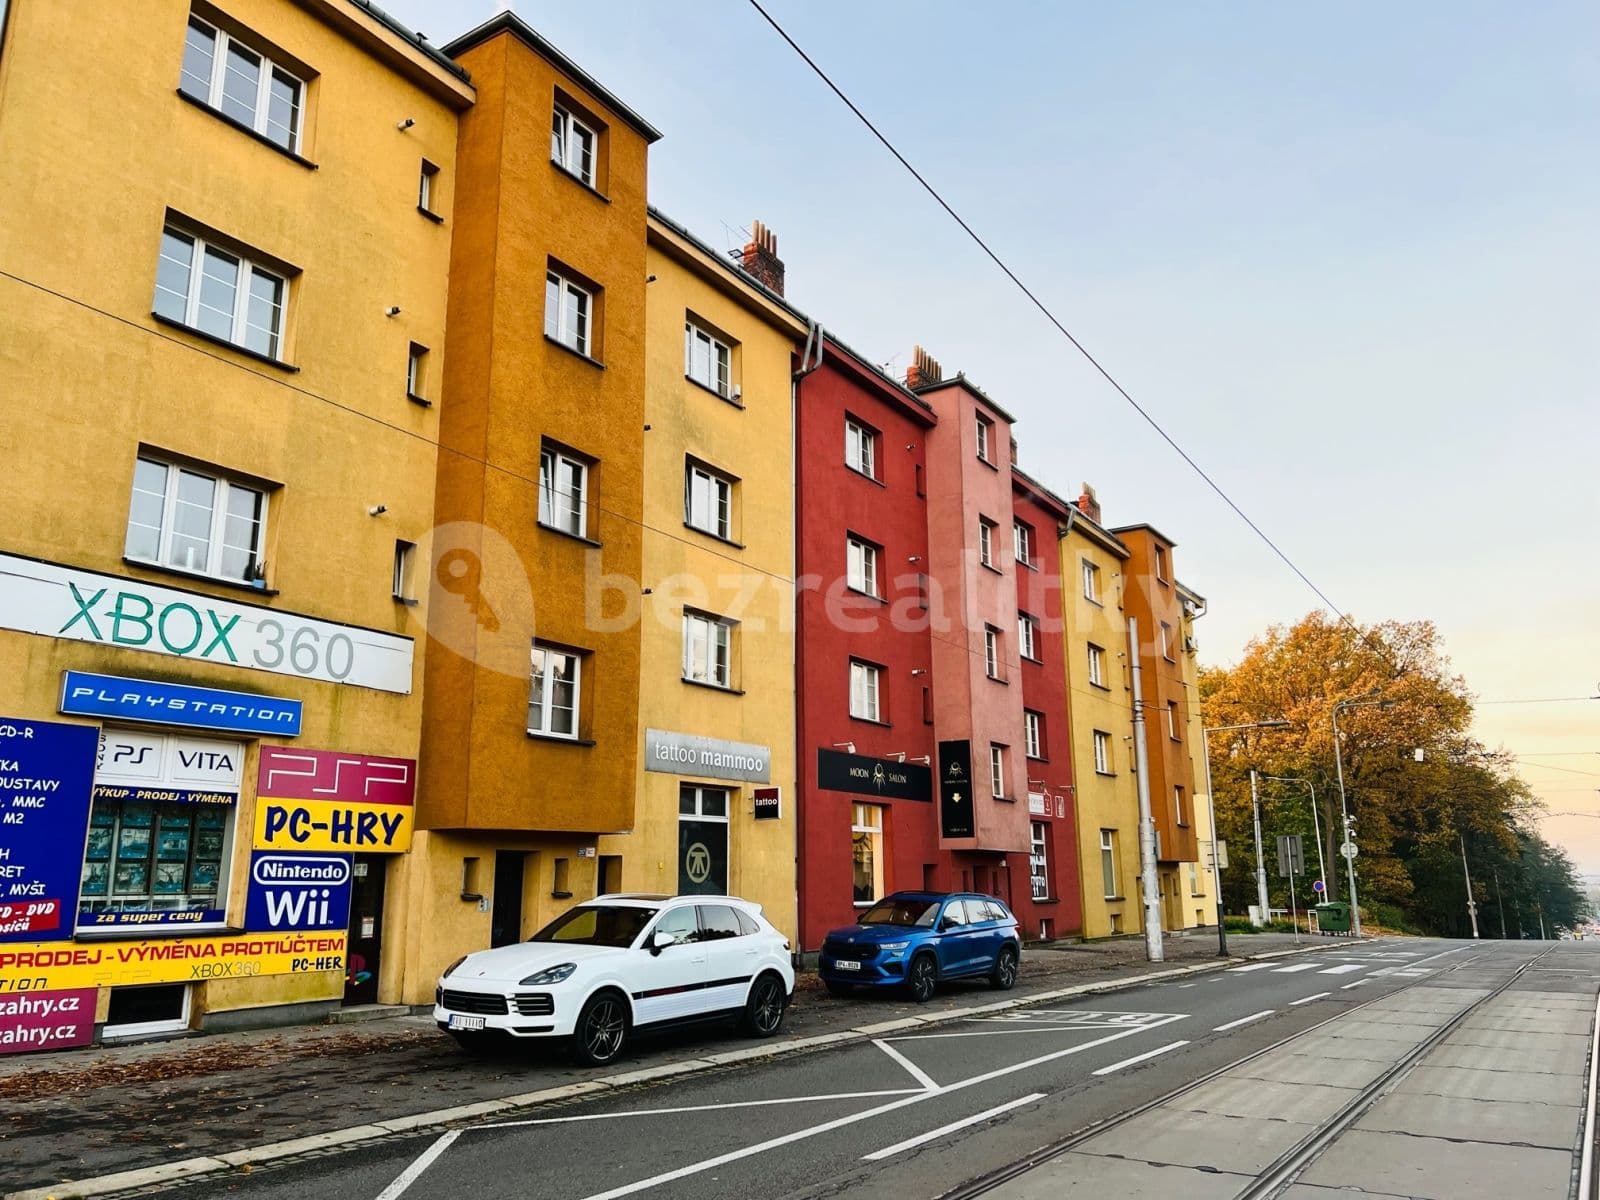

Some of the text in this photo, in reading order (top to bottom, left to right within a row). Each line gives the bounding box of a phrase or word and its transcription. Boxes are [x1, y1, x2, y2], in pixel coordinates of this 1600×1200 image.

[59, 581, 354, 680] XBOX 360
[114, 744, 234, 771] PS VITA
[655, 740, 764, 772] tattoo mammoo
[0, 760, 19, 772] KA
[268, 753, 408, 796] PSP
[850, 767, 907, 784] MOON SALON
[12, 796, 46, 808] MMC
[136, 791, 180, 801] PRODEJ
[187, 792, 233, 804] VÝMĚNA
[755, 798, 777, 806] tattoo
[3, 812, 24, 824] M2
[265, 806, 404, 846] PC-HRY
[262, 862, 343, 879] Nintendo
[9, 880, 46, 896] MYŠI
[26, 902, 55, 916] DVD
[265, 889, 330, 927] Wii
[96, 911, 204, 924] za super ceny
[0, 949, 102, 969] PRODEJ
[118, 939, 216, 963] VÝMĚNA
[221, 933, 344, 956] PROTIÚČTEM
[190, 962, 233, 979] XBOX
[233, 961, 262, 976] 360
[291, 956, 344, 972] PC-HER
